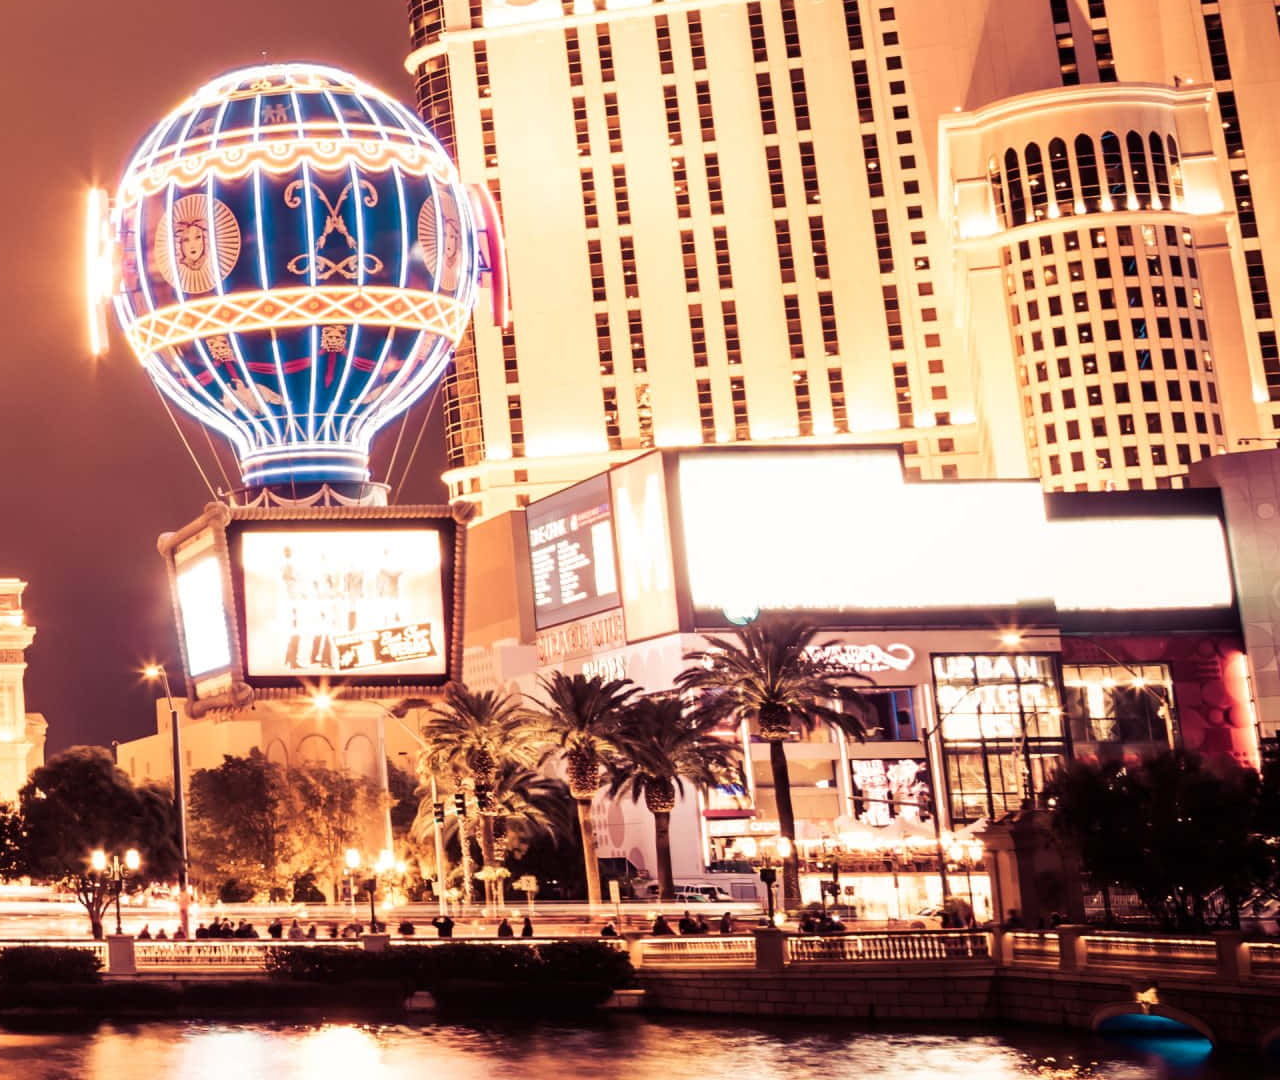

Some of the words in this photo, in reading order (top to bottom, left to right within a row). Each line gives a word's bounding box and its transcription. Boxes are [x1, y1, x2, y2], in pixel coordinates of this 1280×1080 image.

[535, 624, 592, 662] MIRACLE
[592, 615, 623, 647] MILE
[582, 656, 625, 683] SHOPS
[932, 655, 1040, 680] URBAN
